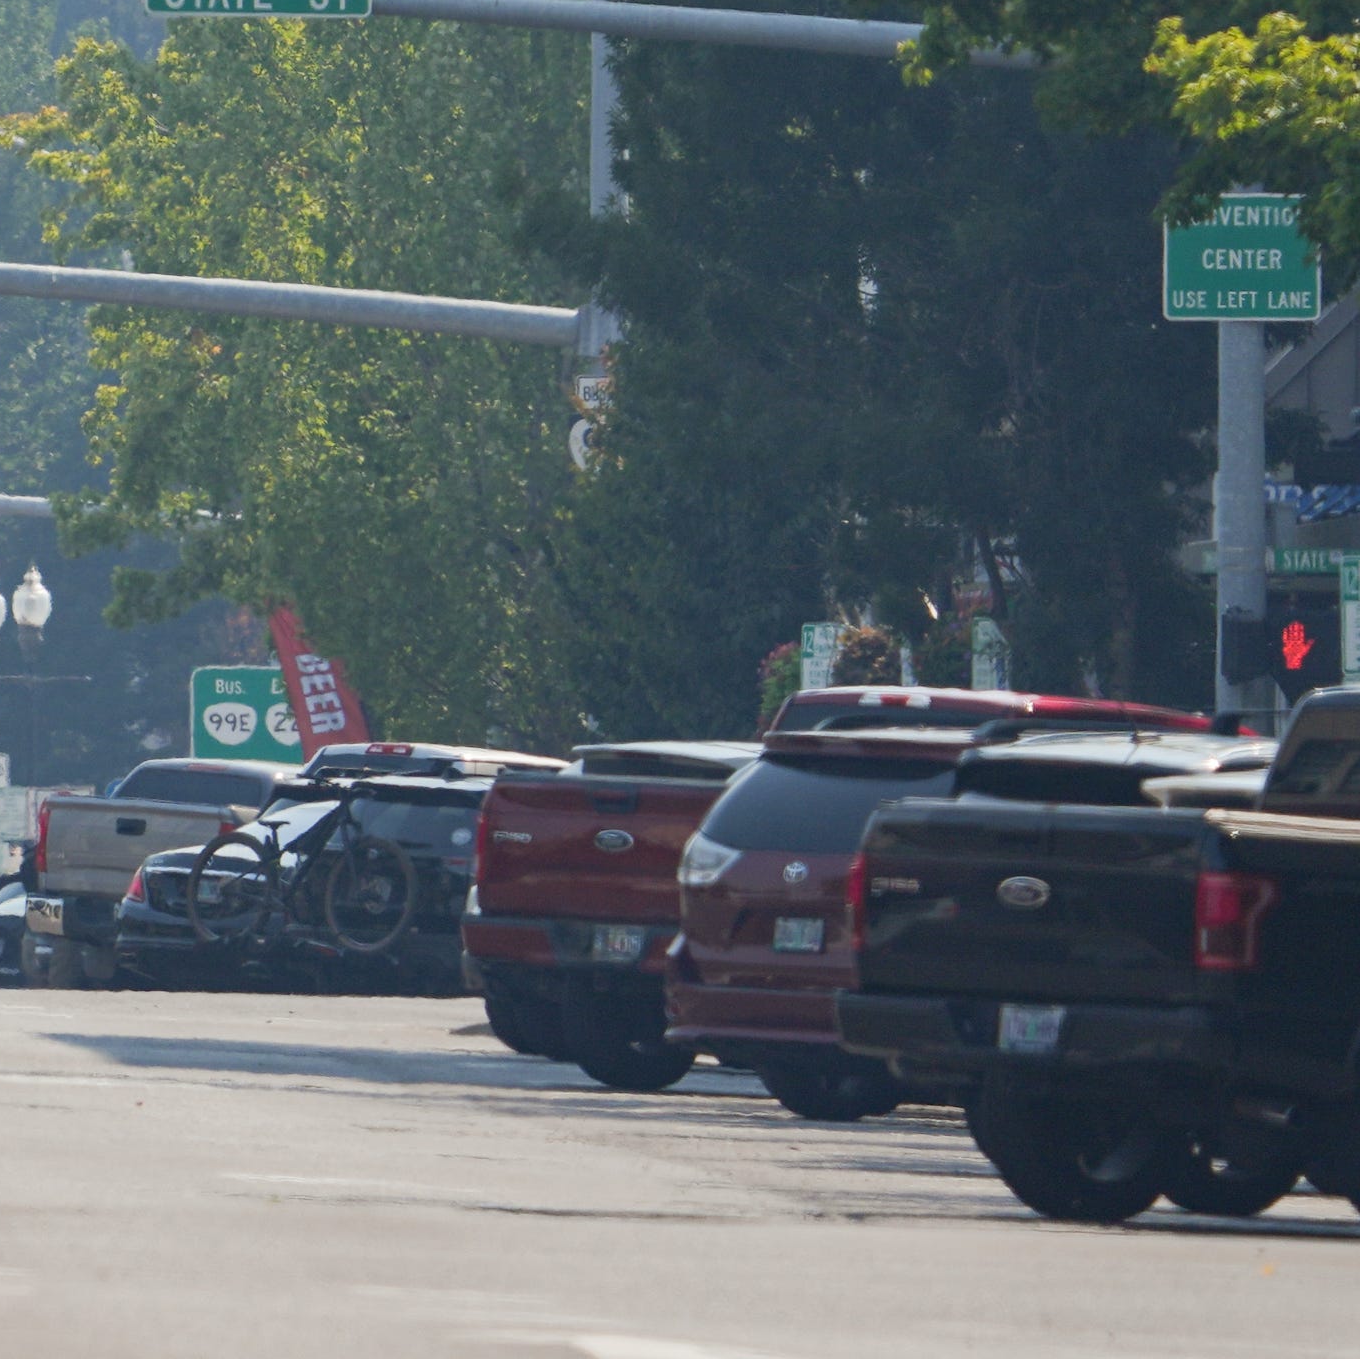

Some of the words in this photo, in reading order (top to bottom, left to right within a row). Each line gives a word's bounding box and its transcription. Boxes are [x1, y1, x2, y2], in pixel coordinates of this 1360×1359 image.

[1202, 249, 1282, 270] CENTER
[1173, 291, 1207, 308] USE
[1217, 291, 1258, 309] LEFT
[1268, 291, 1312, 309] LANE
[1283, 551, 1325, 569] STATE
[296, 654, 346, 735] BEER
[209, 713, 251, 733] 99E
